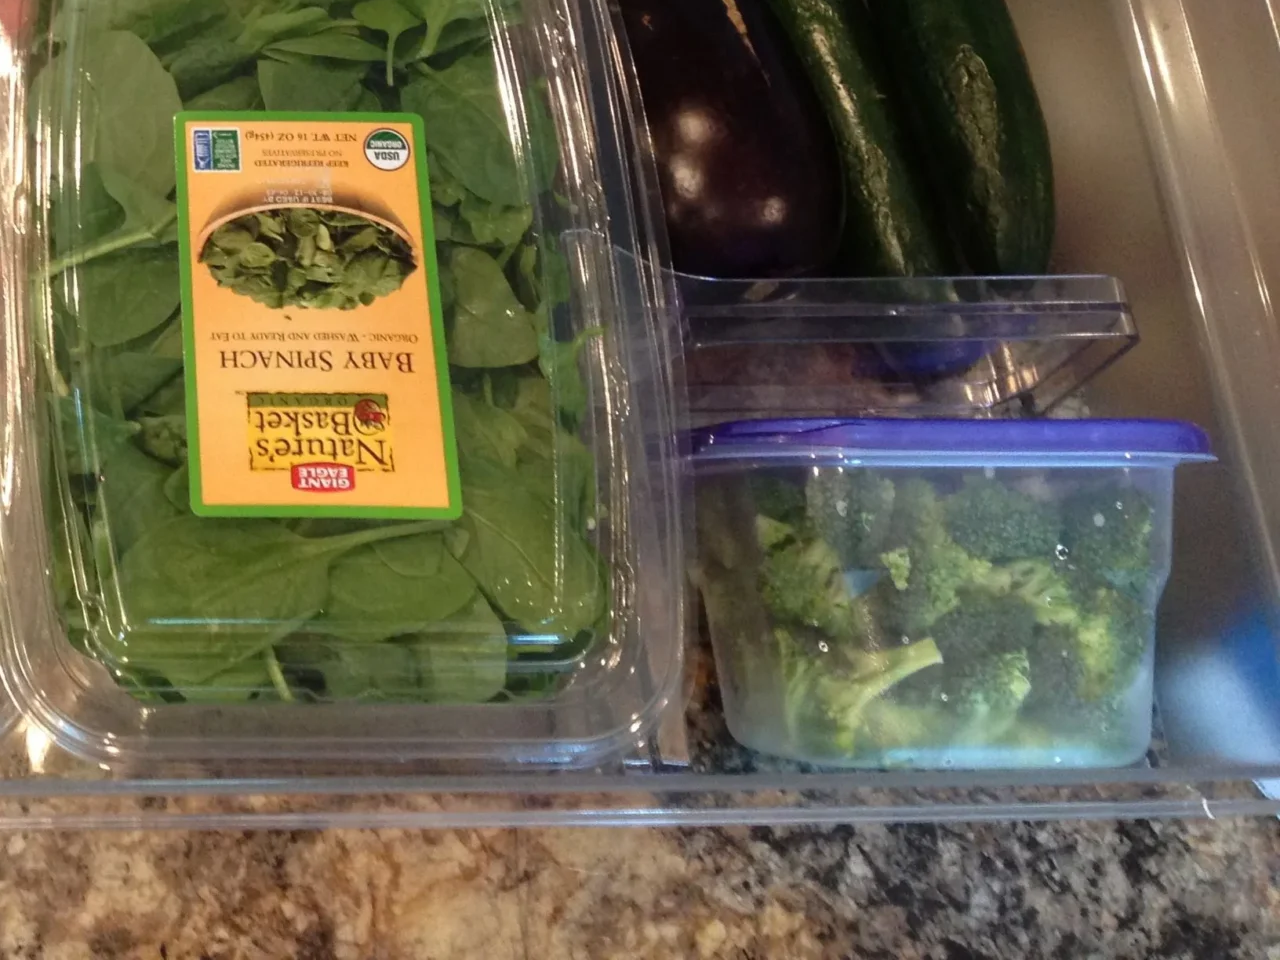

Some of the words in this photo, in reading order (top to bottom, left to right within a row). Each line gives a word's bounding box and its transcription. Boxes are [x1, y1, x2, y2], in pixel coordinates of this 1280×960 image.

[276, 132, 294, 141] OZ
[297, 132, 308, 141] 16
[336, 133, 357, 142] NET
[369, 139, 403, 149] ORGANIC
[261, 148, 326, 157] PRESERVATIVES
[327, 149, 343, 157] NO
[374, 150, 401, 161] USDA
[254, 159, 323, 168] REFRIGERATED
[326, 159, 350, 168] KEEP
[210, 331, 230, 342] EAT
[231, 331, 246, 341] TO
[250, 331, 286, 342] READY
[288, 331, 311, 341] AND
[313, 332, 360, 343] WASHED
[370, 332, 419, 344] ORGANIC
[219, 350, 333, 372] SPINACH
[343, 351, 416, 374] BABY
[256, 394, 348, 407] ORGANIC
[254, 411, 352, 437] Basket
[257, 438, 388, 466] Nature's
[298, 467, 349, 478] EAGLE
[298, 476, 351, 488] GIANT
